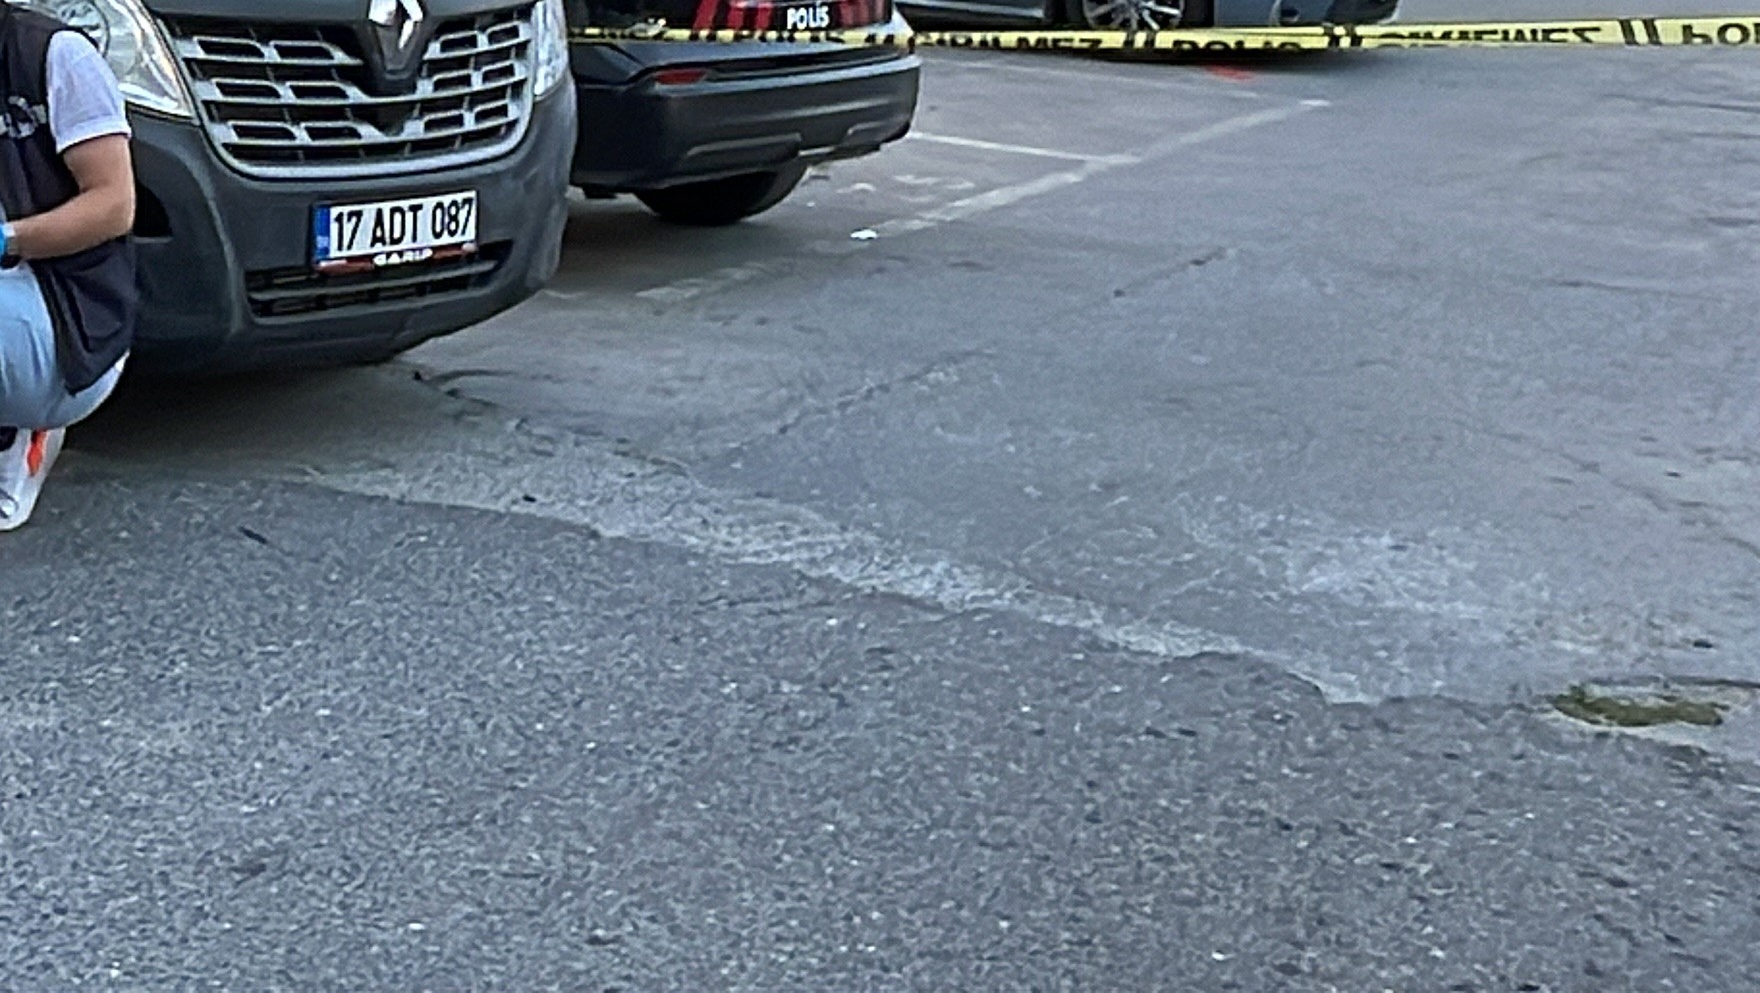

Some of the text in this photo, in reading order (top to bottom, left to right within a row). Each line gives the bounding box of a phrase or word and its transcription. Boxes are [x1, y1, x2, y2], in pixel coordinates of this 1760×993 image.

[334, 197, 474, 252] 17 ADT 087
